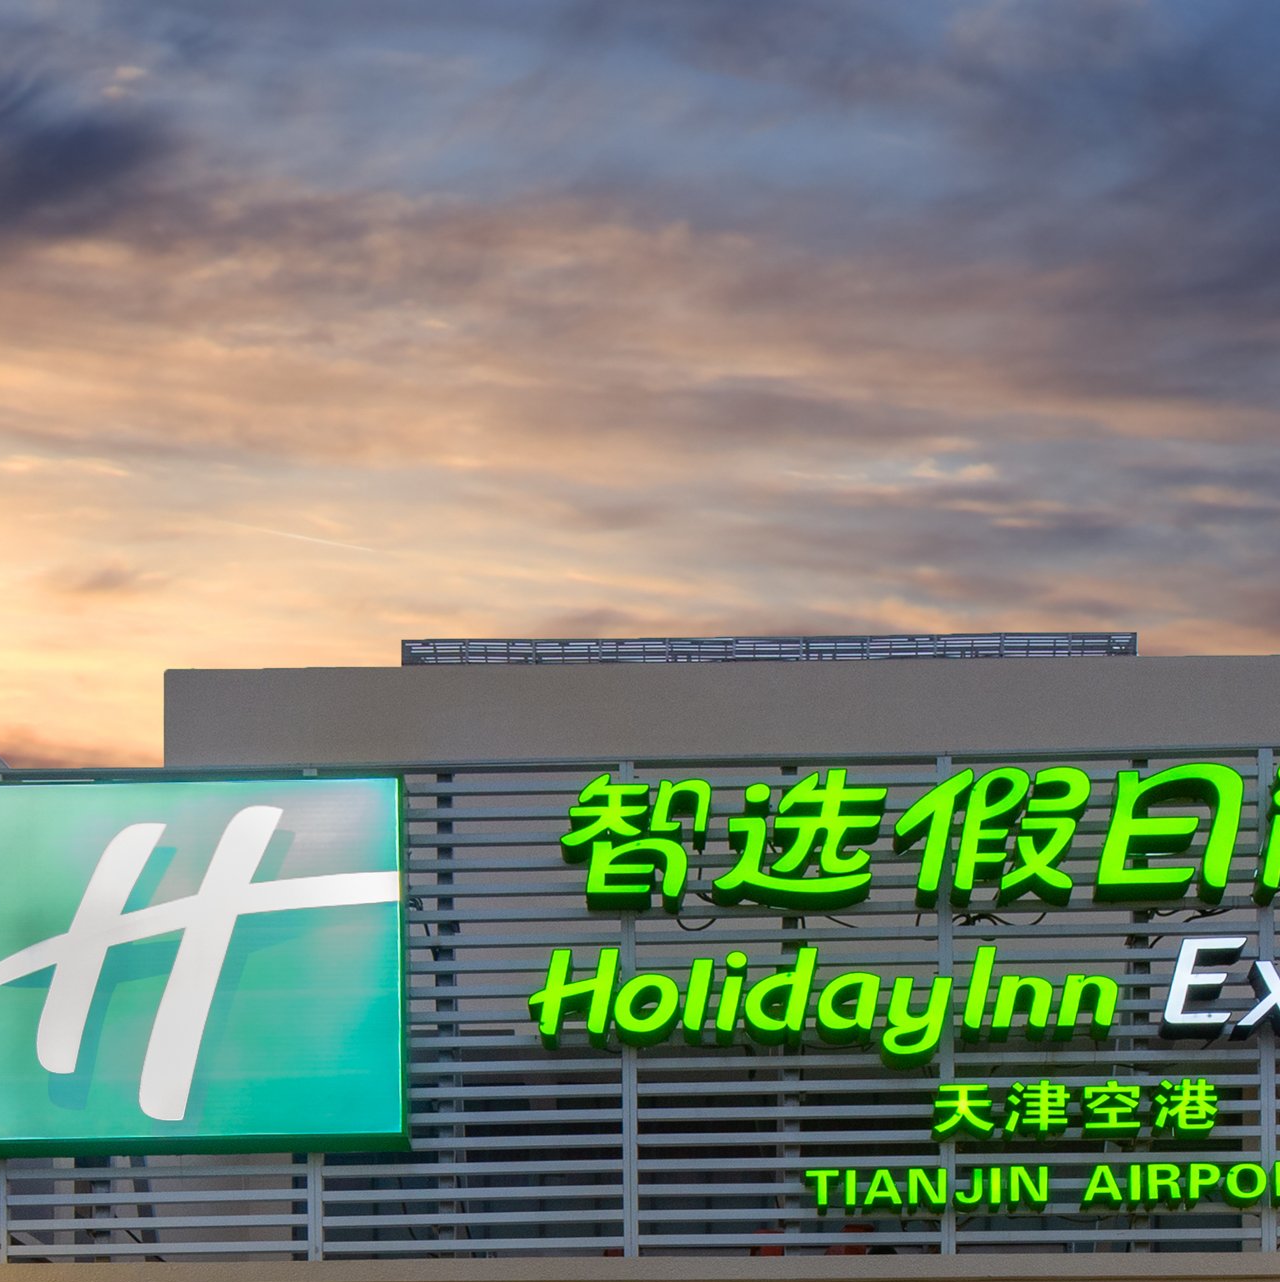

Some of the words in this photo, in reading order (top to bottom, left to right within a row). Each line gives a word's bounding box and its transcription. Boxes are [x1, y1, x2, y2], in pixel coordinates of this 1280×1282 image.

[932, 1078, 1219, 1136] 天津空港
[805, 1166, 1050, 1208] TIANJIN
